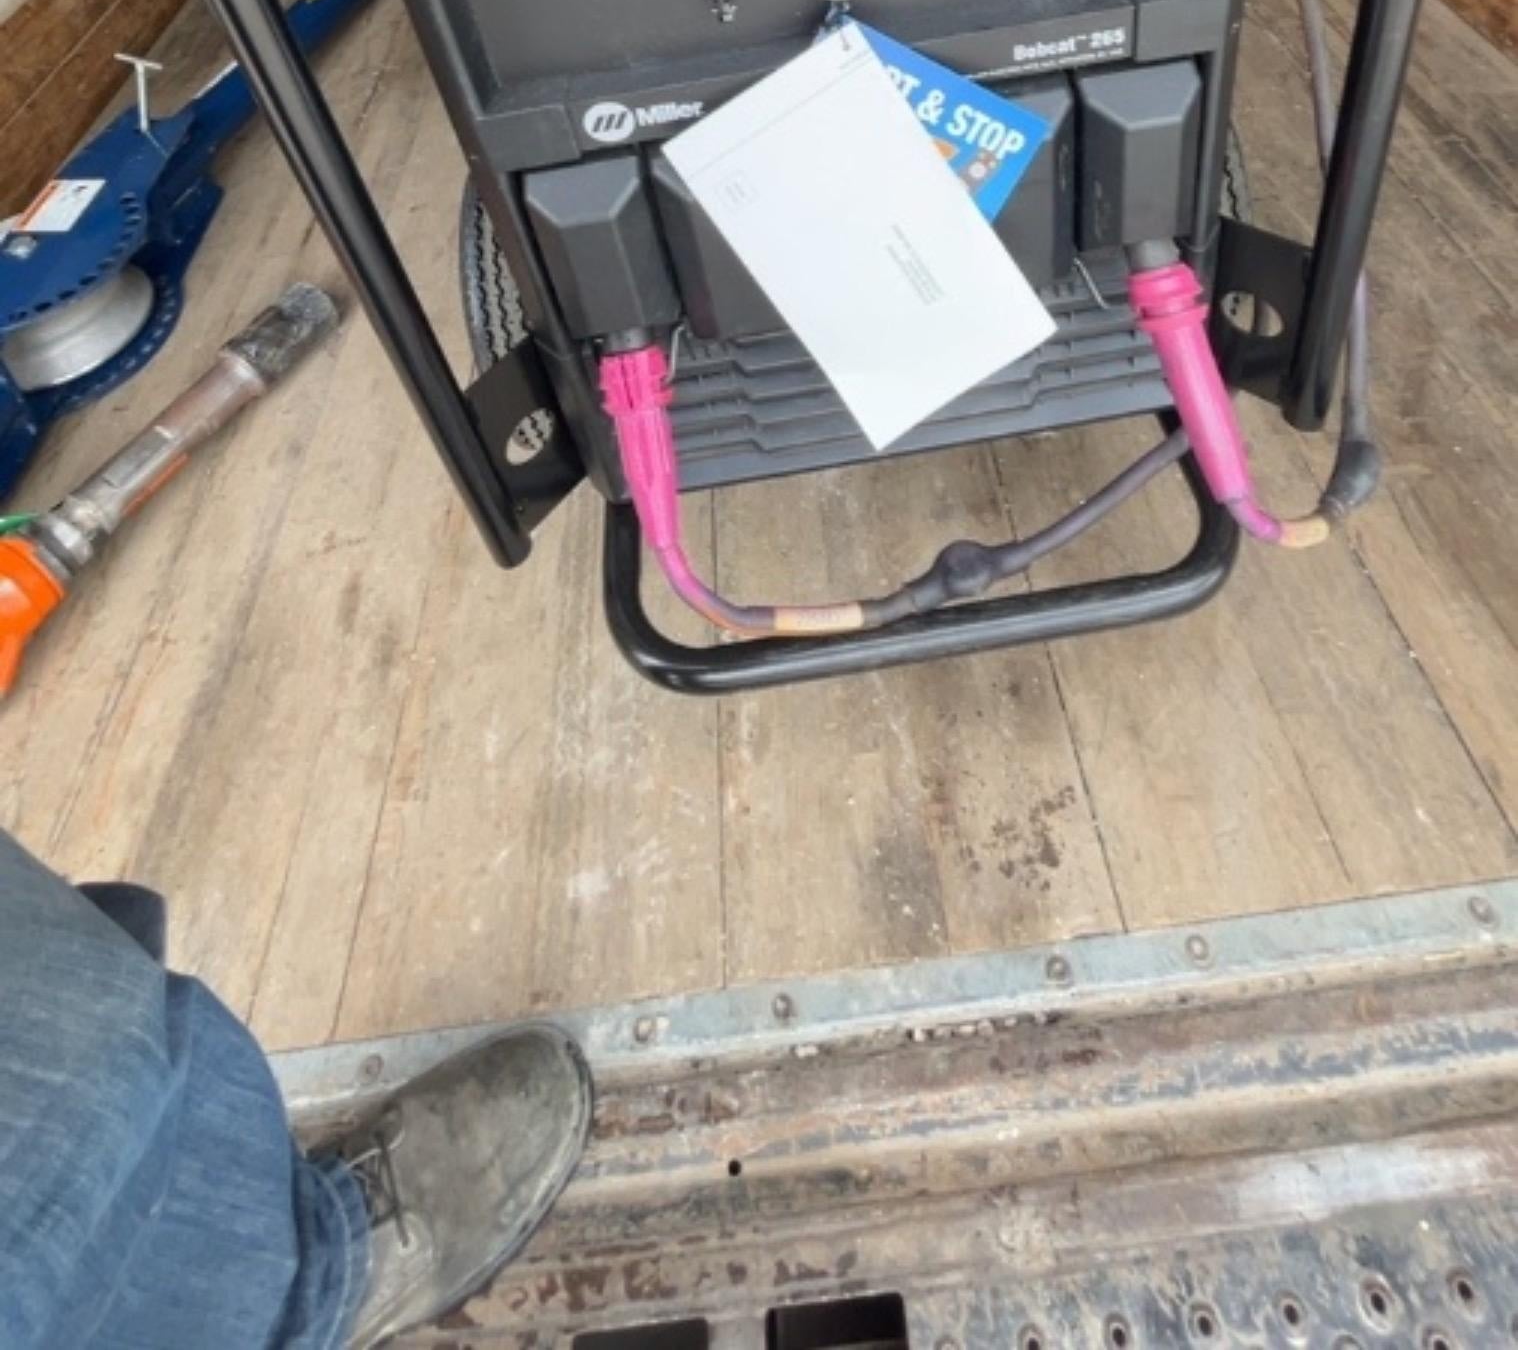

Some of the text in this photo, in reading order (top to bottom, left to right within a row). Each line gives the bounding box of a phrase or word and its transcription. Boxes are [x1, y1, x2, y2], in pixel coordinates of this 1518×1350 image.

[635, 101, 703, 127] Miller
[917, 89, 946, 127] &
[946, 103, 1026, 161] STOP
